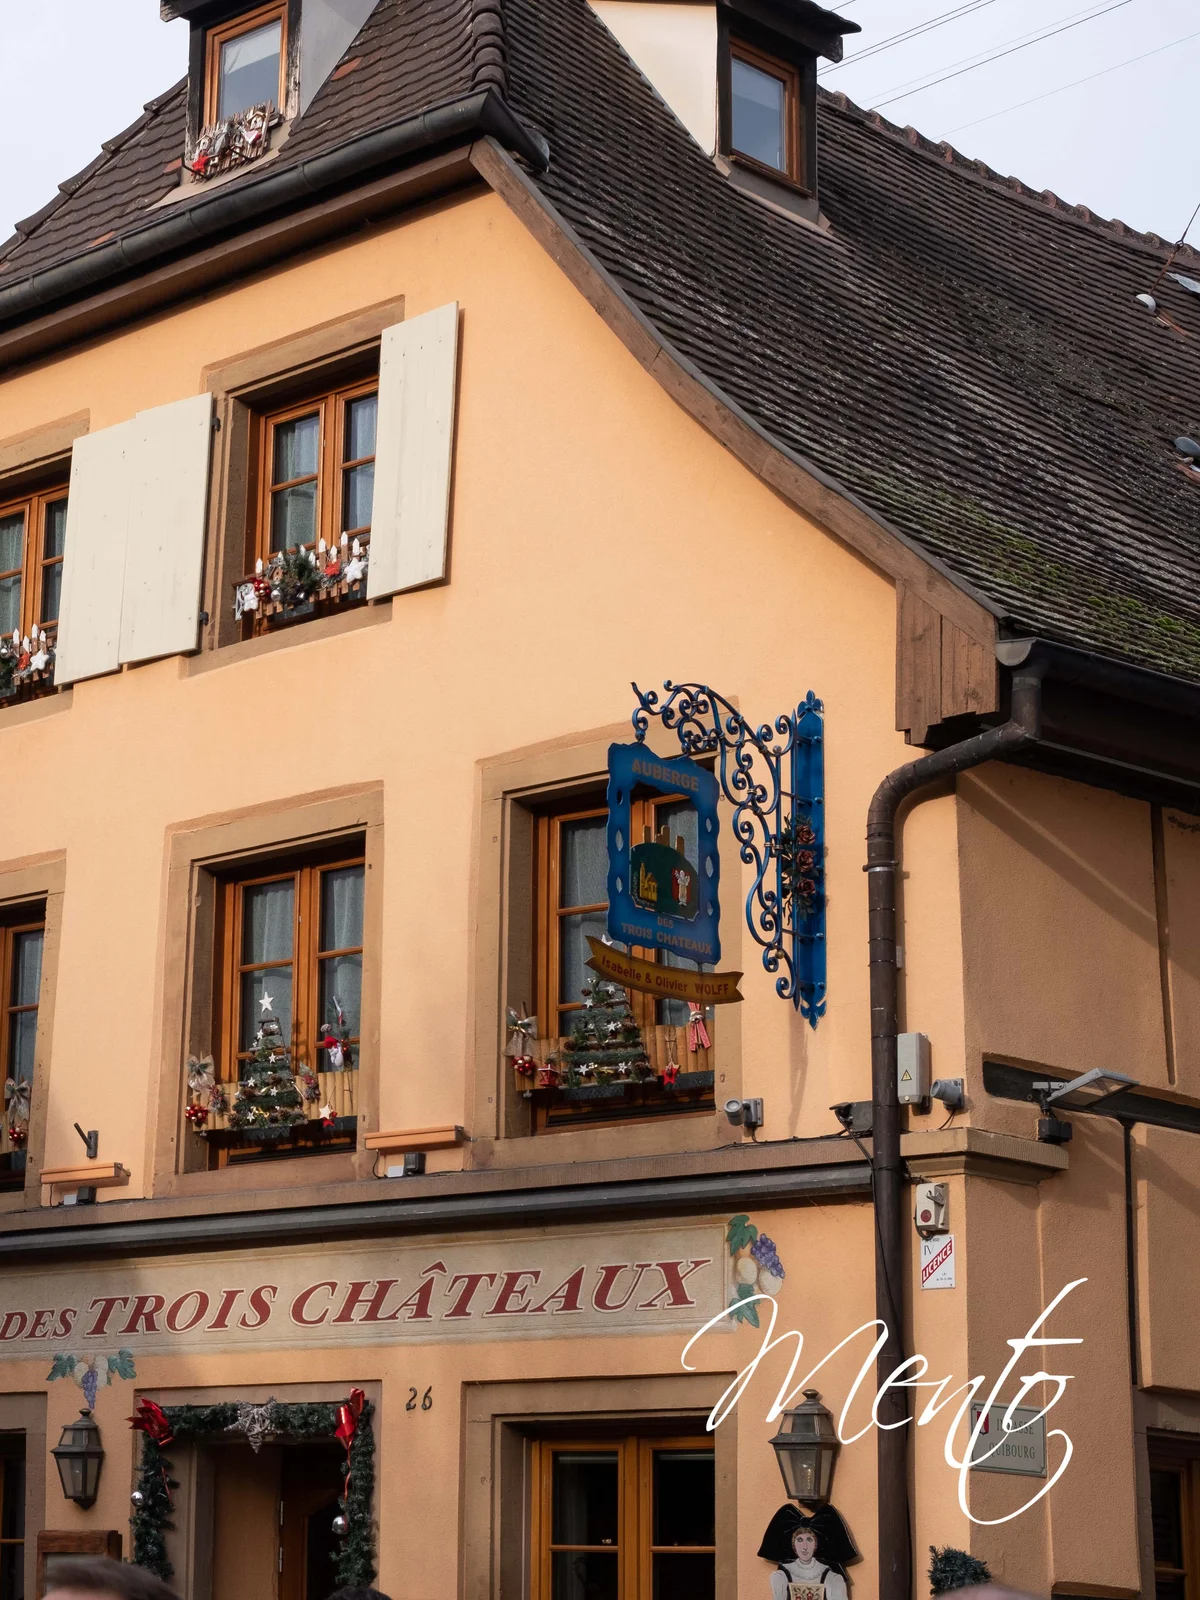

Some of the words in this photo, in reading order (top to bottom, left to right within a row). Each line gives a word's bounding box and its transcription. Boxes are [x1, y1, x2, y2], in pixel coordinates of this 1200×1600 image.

[632, 759, 700, 793] AUBERGE
[621, 922, 653, 940] TROIS
[656, 931, 712, 955] CHATEAUX
[657, 916, 674, 929] DES
[601, 955, 642, 982] Isabelle
[644, 972, 653, 984] &
[655, 975, 688, 993] Olivier
[694, 982, 730, 997] WOLFF
[922, 1242, 952, 1282] LICENCE
[83, 1285, 279, 1338] TROIS
[289, 1259, 712, 1326] CHÂTEAUX
[405, 1385, 433, 1412] 26
[989, 1442, 1035, 1459] QUIBOURG
